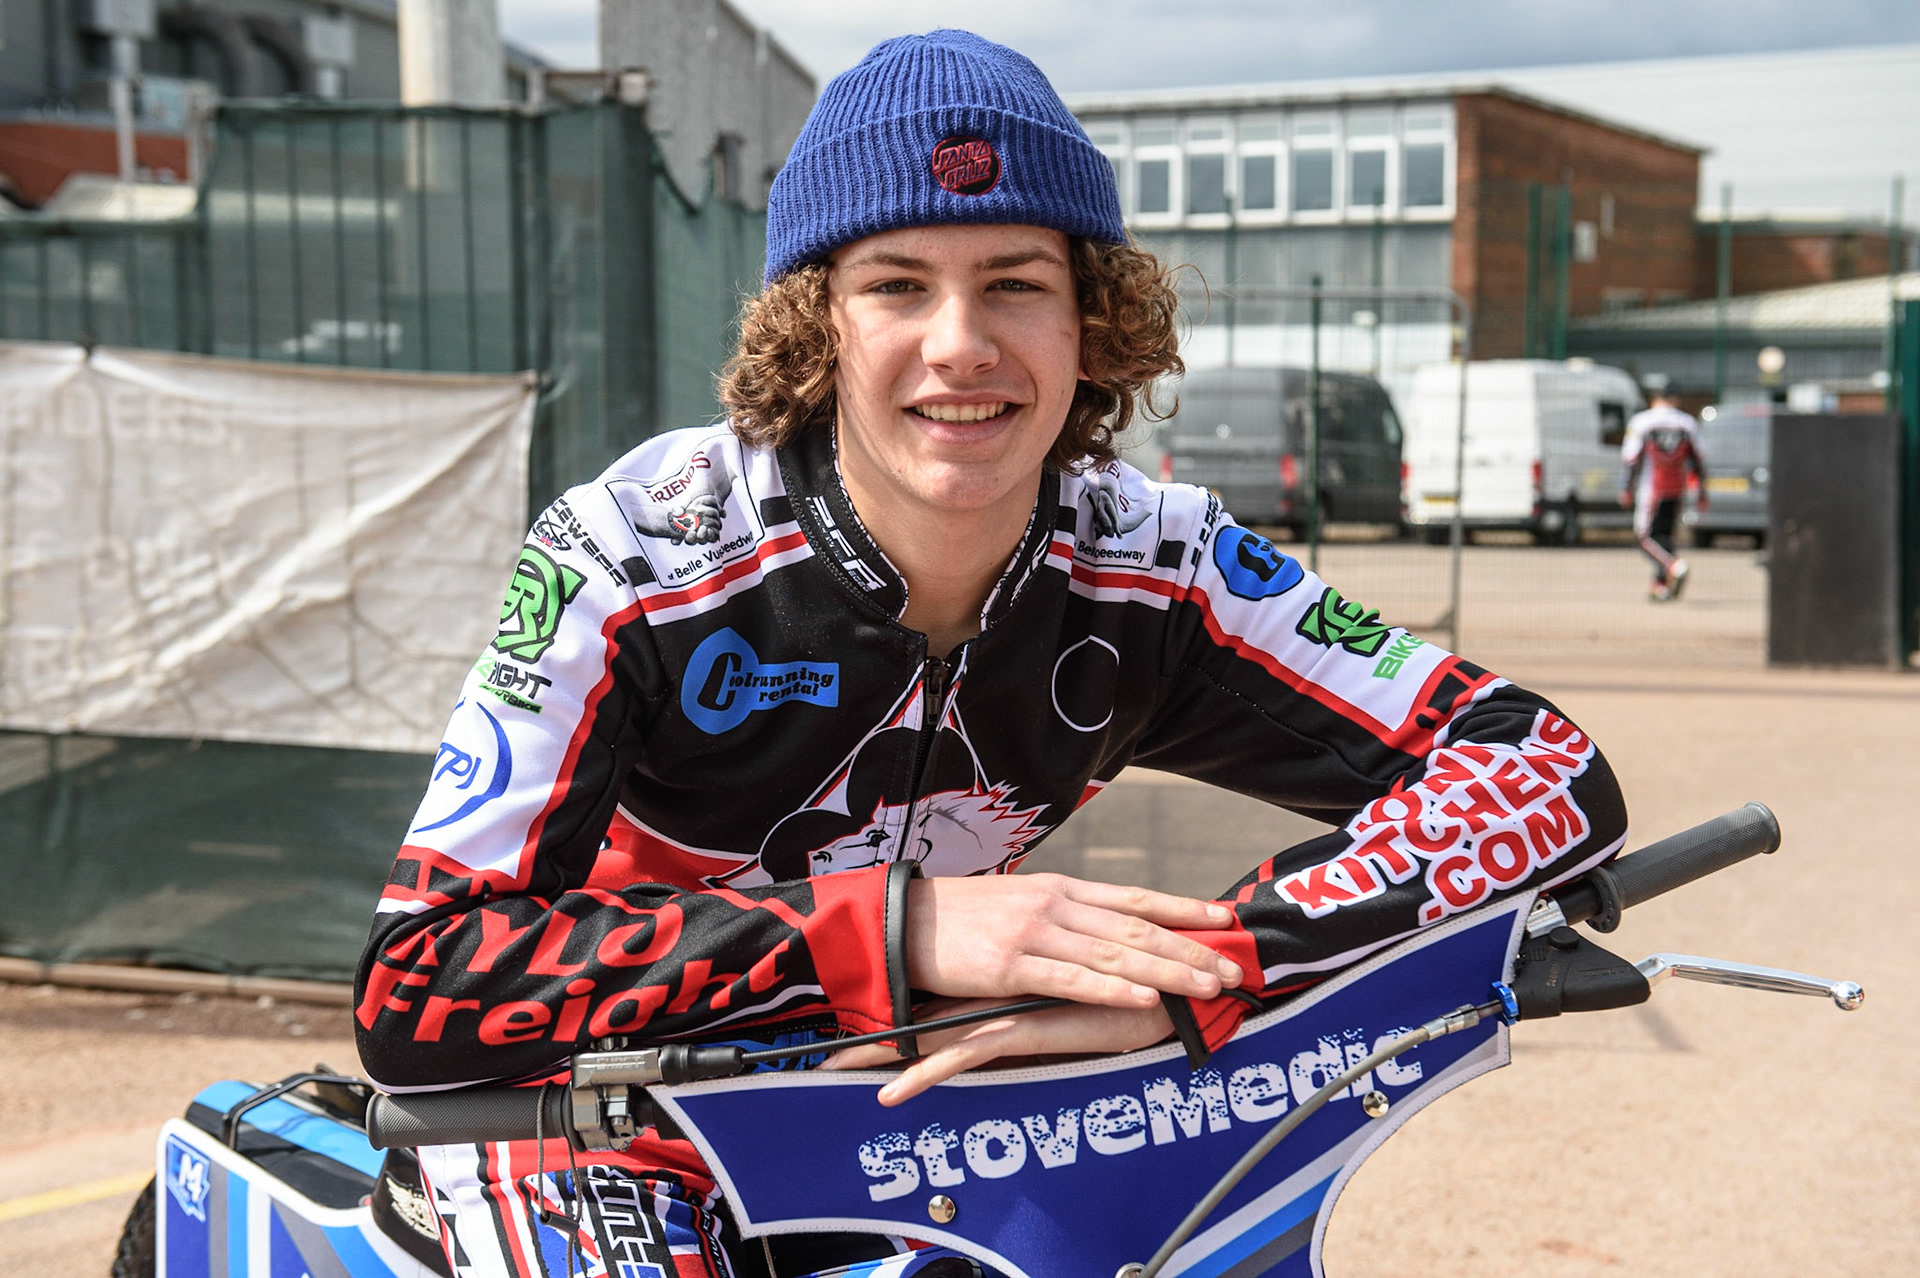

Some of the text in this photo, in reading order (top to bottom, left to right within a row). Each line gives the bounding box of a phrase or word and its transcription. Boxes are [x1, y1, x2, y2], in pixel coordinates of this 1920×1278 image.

[933, 140, 992, 174] SANTA
[943, 158, 992, 190] CRUZ
[674, 559, 703, 578] Belle
[697, 652, 835, 711] Coolrunning
[759, 684, 819, 703] rental
[1283, 711, 1590, 910] KITCHENS
[1427, 795, 1584, 921] .COM
[355, 939, 790, 1047] Freight
[858, 1025, 1424, 1203] StoveMedic
